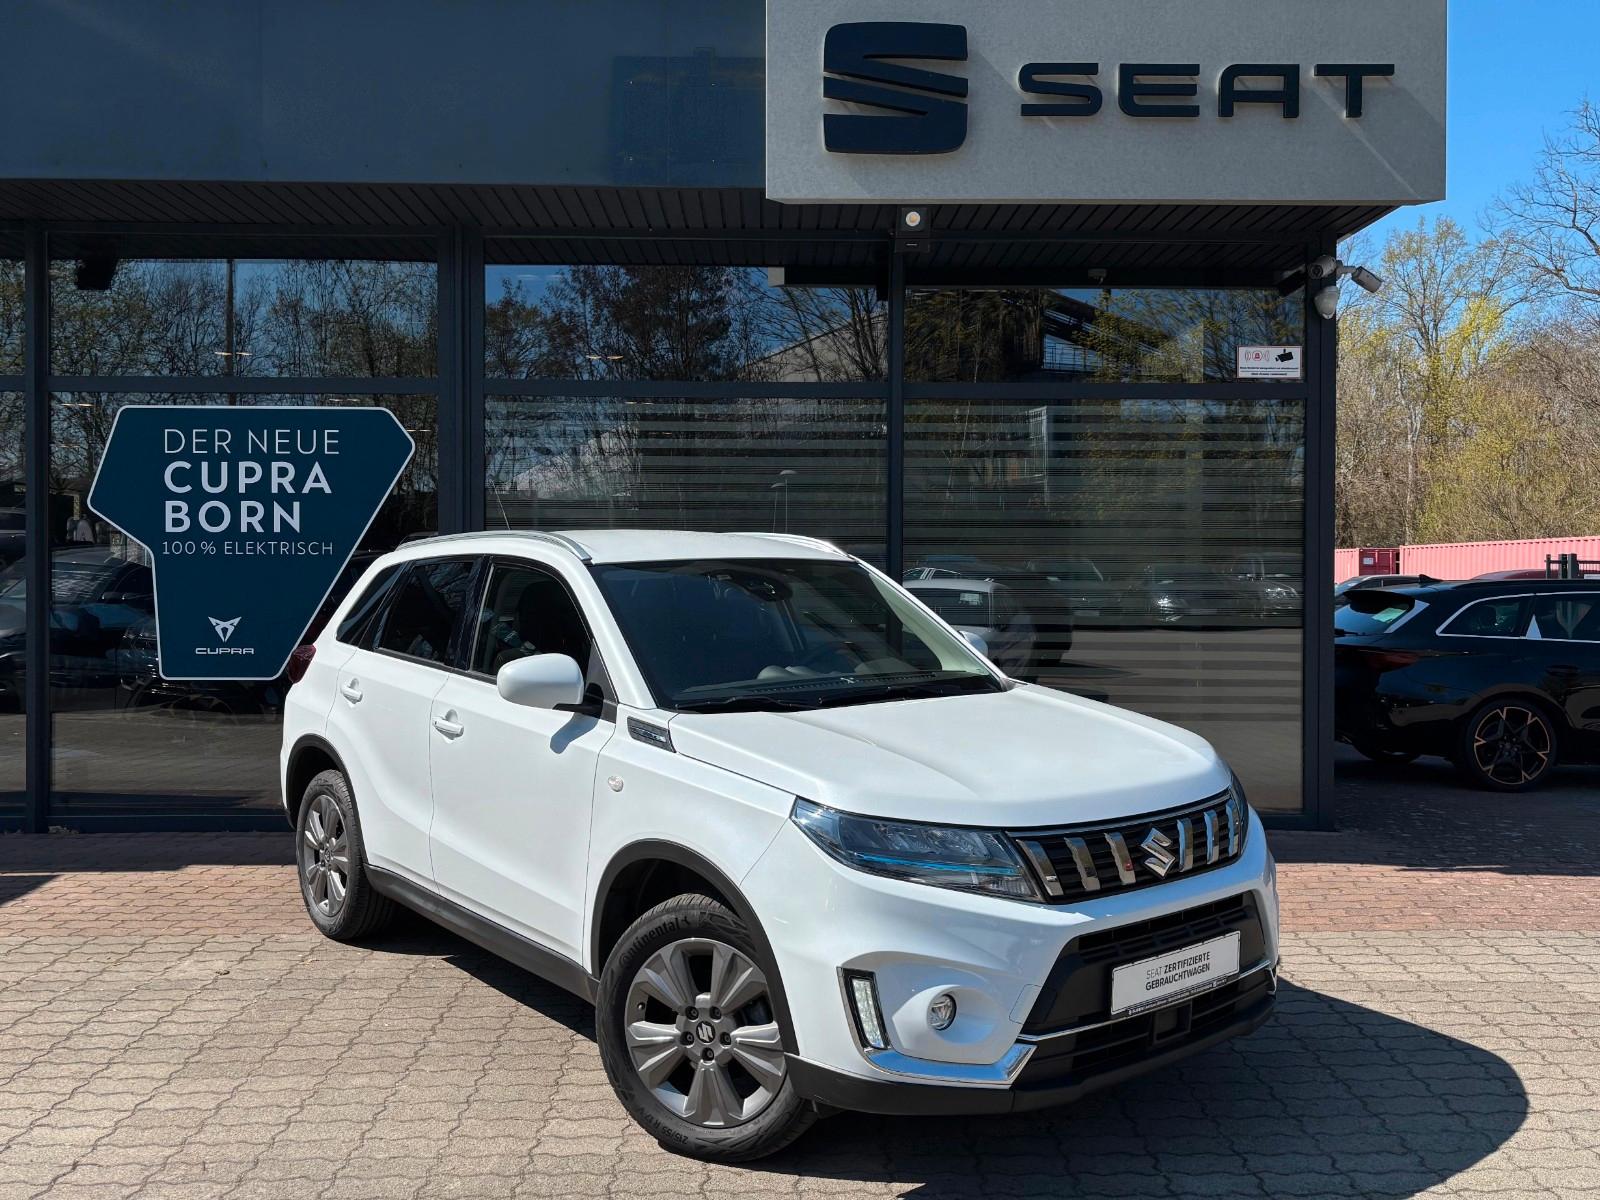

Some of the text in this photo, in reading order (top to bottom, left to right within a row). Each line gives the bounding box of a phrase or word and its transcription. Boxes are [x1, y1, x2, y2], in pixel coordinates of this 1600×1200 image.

[1019, 63, 1394, 119] SEAT
[165, 429, 339, 454] DER NEUE
[164, 461, 332, 493] CUPRA
[165, 501, 300, 532] BORN
[225, 542, 332, 554] ELEKTRISCH
[619, 917, 681, 968] Continental
[1145, 962, 1211, 991] GEBRAUCHTWAGEN
[1146, 951, 1211, 980] SEAT ZERTIFIZIERTE
